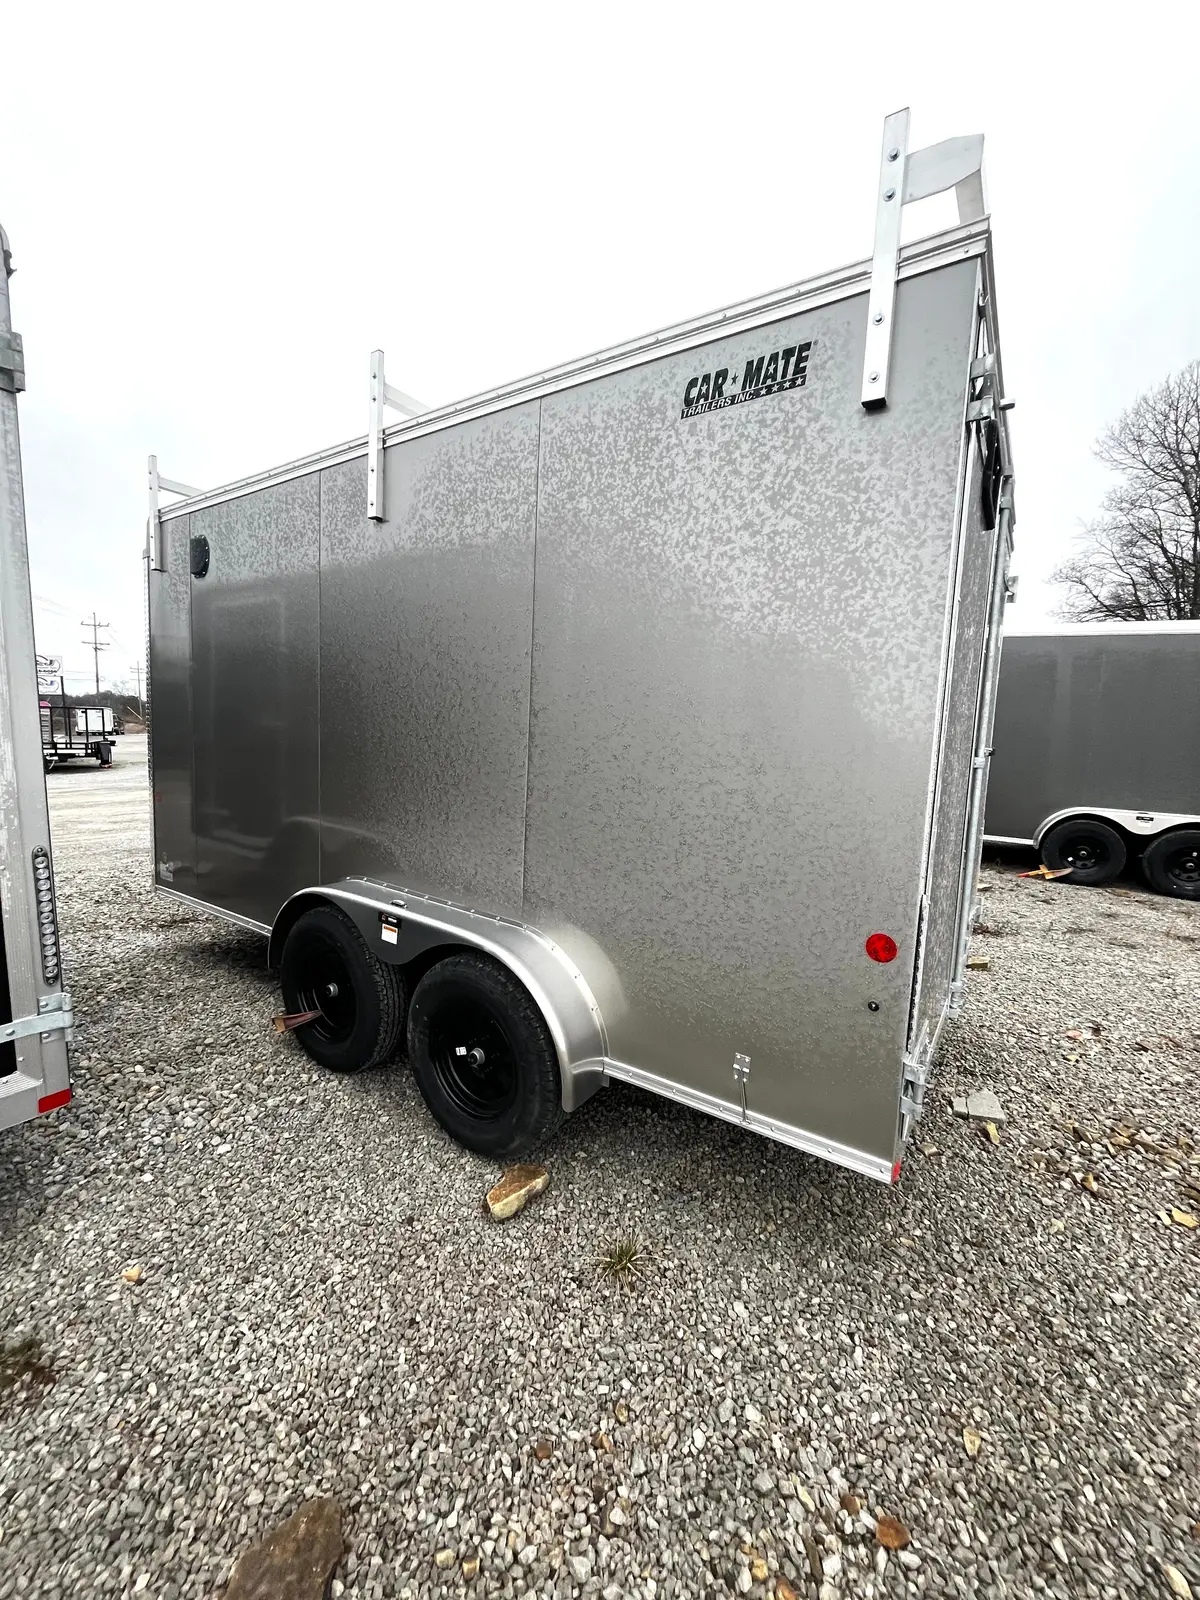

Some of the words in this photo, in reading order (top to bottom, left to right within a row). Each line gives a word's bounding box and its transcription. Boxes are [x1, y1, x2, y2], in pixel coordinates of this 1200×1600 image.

[683, 367, 729, 408] CAR
[741, 341, 812, 391] MATE
[682, 398, 732, 418] TRAILERS
[734, 390, 756, 404] INC.
